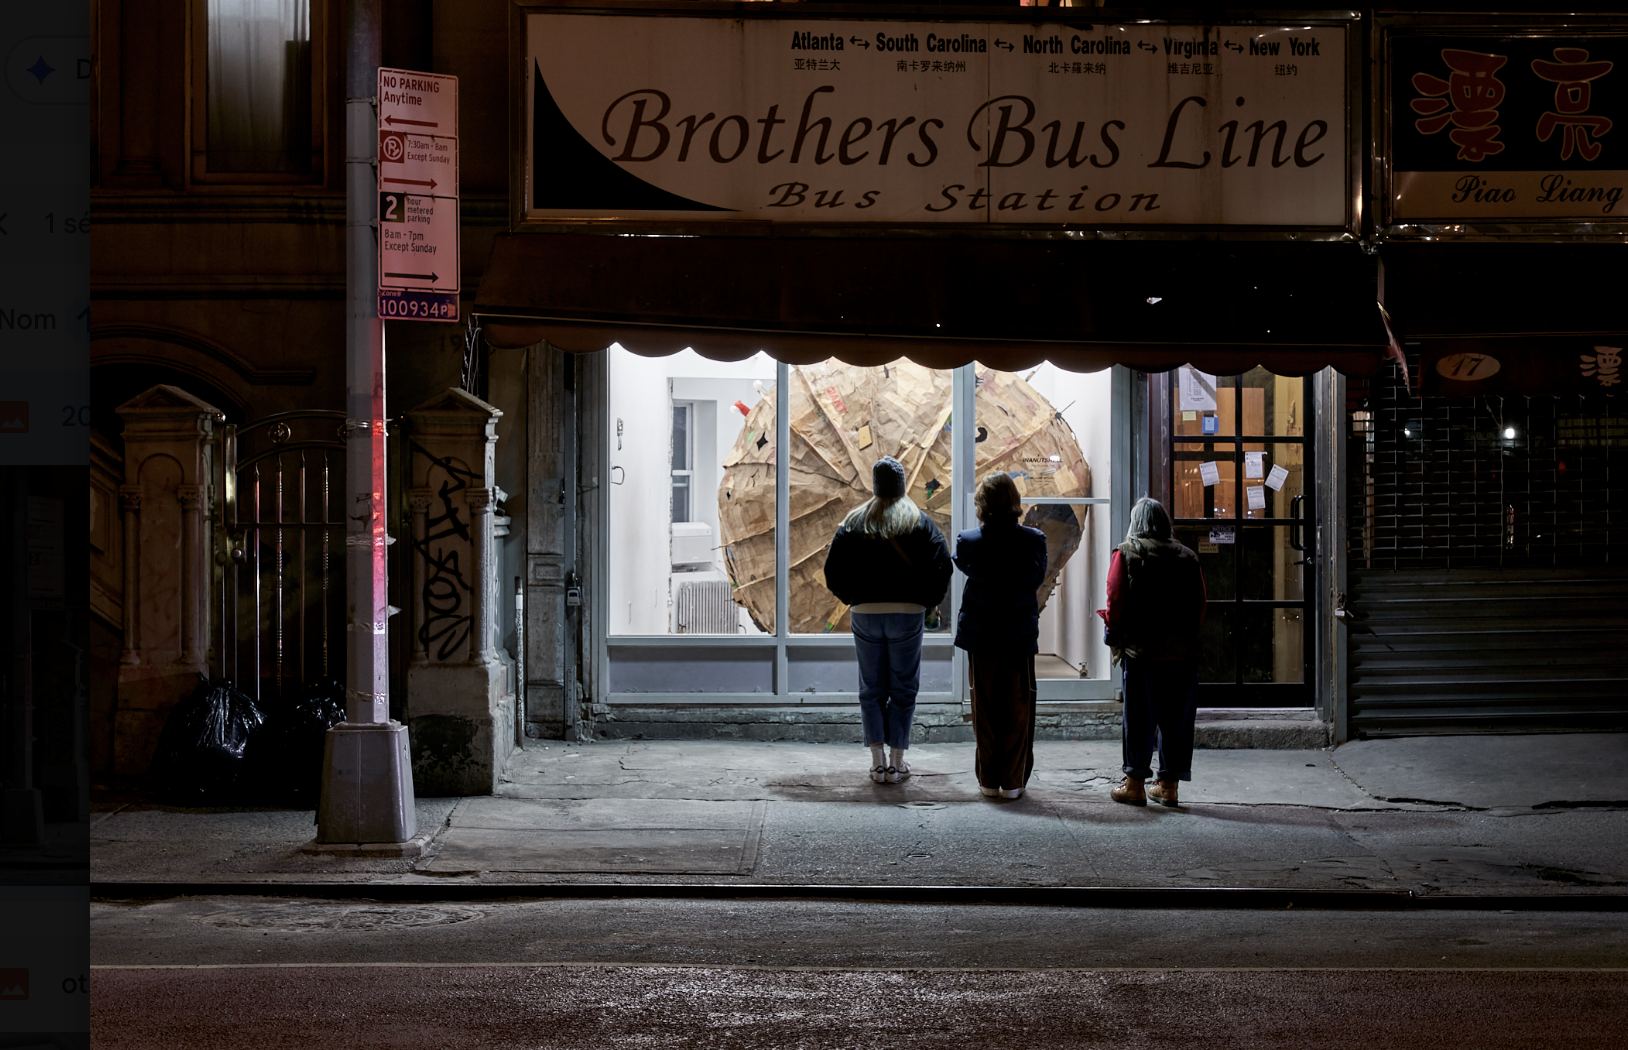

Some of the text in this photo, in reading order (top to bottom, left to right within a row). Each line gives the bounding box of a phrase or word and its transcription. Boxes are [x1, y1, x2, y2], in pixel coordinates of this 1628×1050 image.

[791, 31, 1321, 59] Atlanta South Carolina North Carolina Virginia New York
[793, 58, 841, 71] 亚特兰大
[896, 60, 966, 73] 南卡罗来纳州
[1167, 62, 1214, 75] 维吉尼亚
[1274, 64, 1298, 76] 纽约
[383, 75, 440, 93] NO PARKING
[383, 90, 423, 106] Anytime
[1409, 47, 1614, 162] 漂亮
[602, 85, 1329, 170] Brothers Bus Line
[407, 140, 430, 151] 7:30am
[435, 143, 448, 152] 8am
[407, 151, 451, 166] Except Sunday
[407, 196, 422, 206] hour
[766, 181, 1162, 212] Bus Station
[1451, 174, 1625, 214] Piao Liang
[385, 194, 398, 220] 2
[407, 206, 434, 216] metered
[407, 215, 431, 225] parking
[384, 228, 402, 240] 8am
[408, 230, 424, 242] 7pm
[384, 240, 438, 256] Except Sunday
[381, 299, 440, 318] 100934
[0, 308, 56, 330] Nom
[1450, 356, 1487, 377] 17
[1579, 345, 1623, 387] 漂
[826, 385, 847, 413] GIANT
